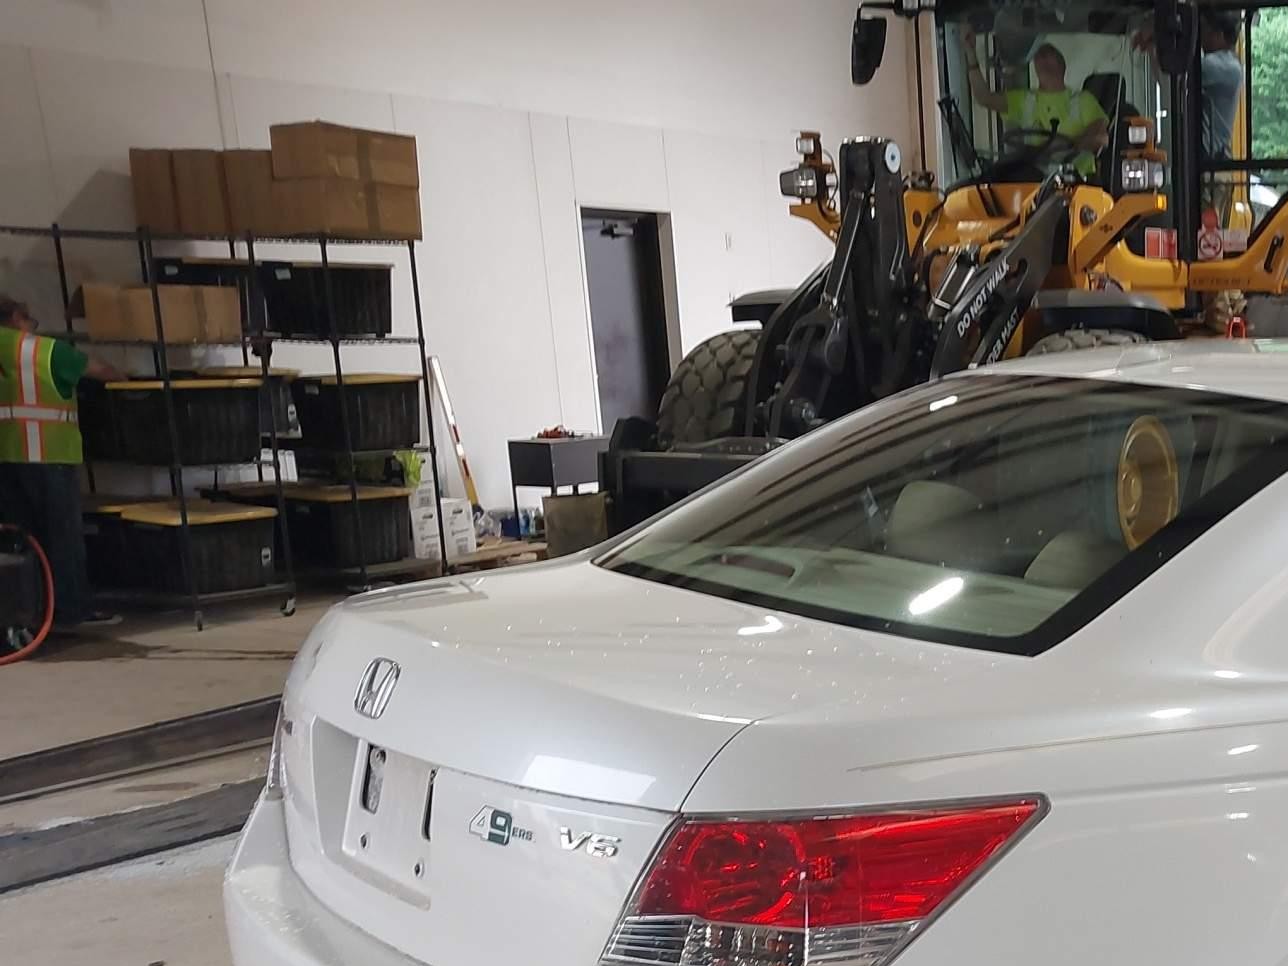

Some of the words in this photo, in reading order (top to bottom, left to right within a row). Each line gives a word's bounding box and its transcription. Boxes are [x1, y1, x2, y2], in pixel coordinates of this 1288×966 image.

[956, 315, 971, 338] DO
[968, 285, 989, 319] NOT
[985, 256, 1010, 294] WALK
[1001, 305, 1020, 345] MAST
[559, 825, 623, 858] V6
